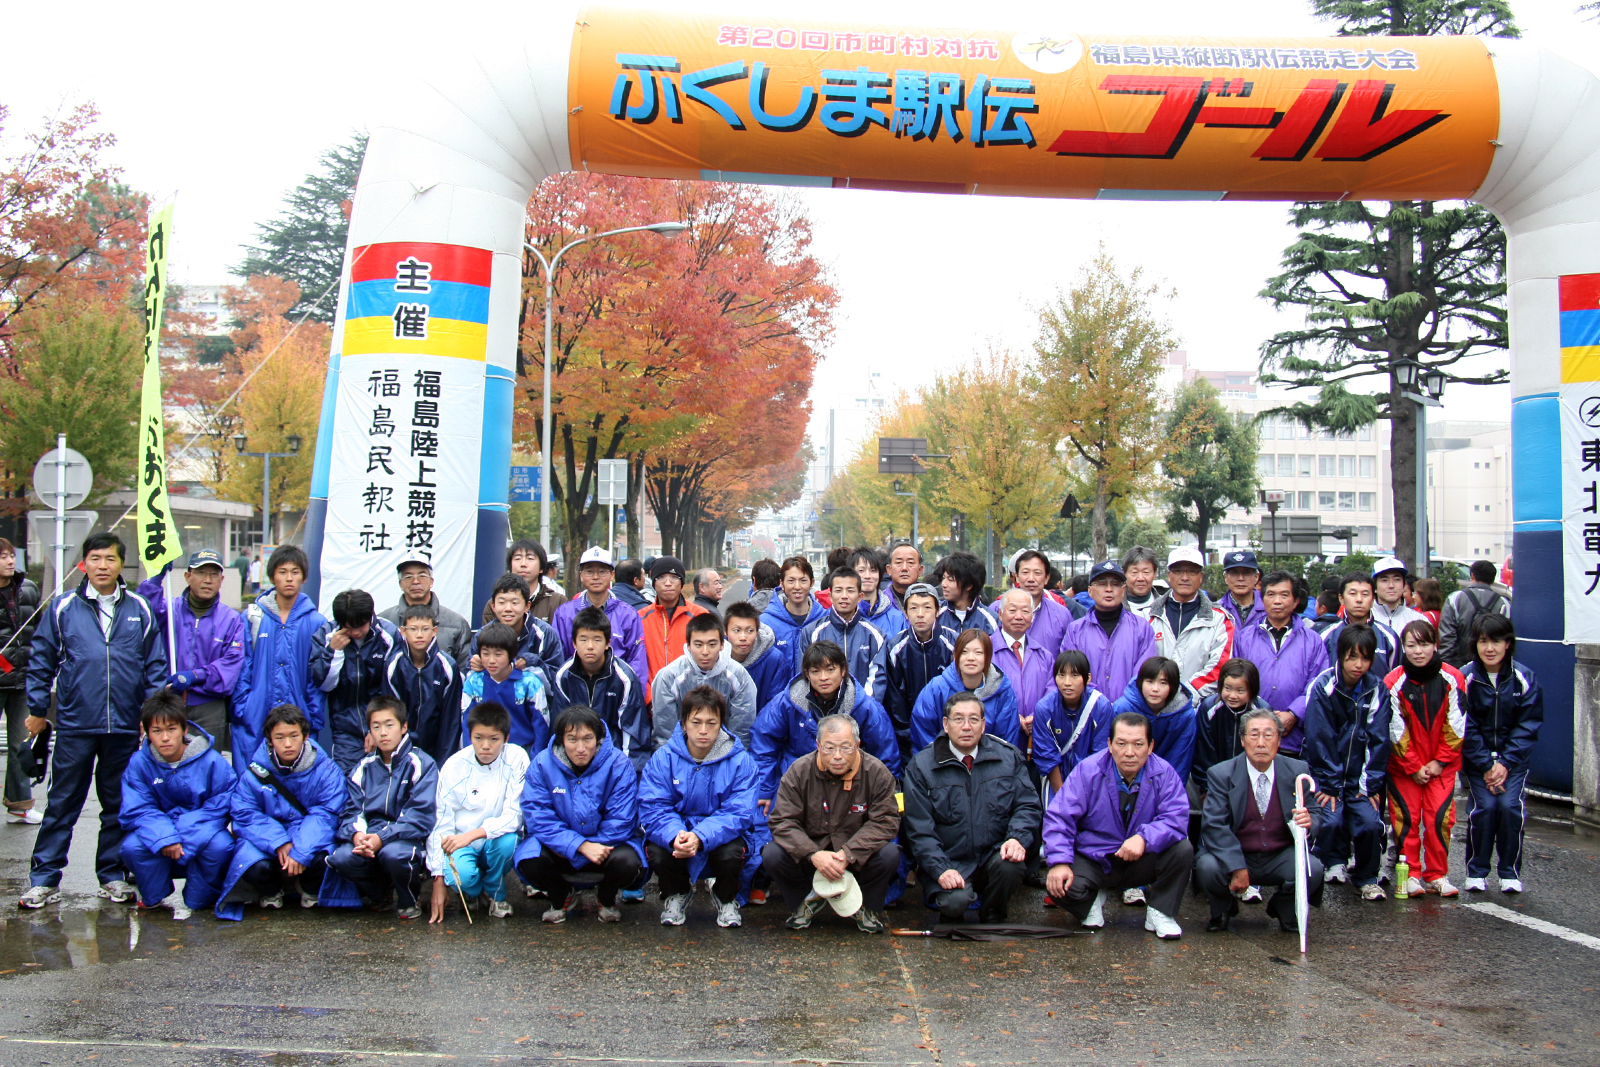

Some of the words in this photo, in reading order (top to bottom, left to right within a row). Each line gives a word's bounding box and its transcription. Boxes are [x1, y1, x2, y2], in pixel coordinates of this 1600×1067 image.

[718, 25, 999, 60] 第20回市町村対抗
[1091, 44, 1419, 70] 福島県縦断駅伝競走大会
[608, 53, 1039, 149] ふくしま駅伝
[1046, 74, 1453, 162] ゴール
[393, 258, 432, 340] 主催
[359, 369, 401, 553] 福島民報社
[406, 369, 442, 560] 福島陸上競技
